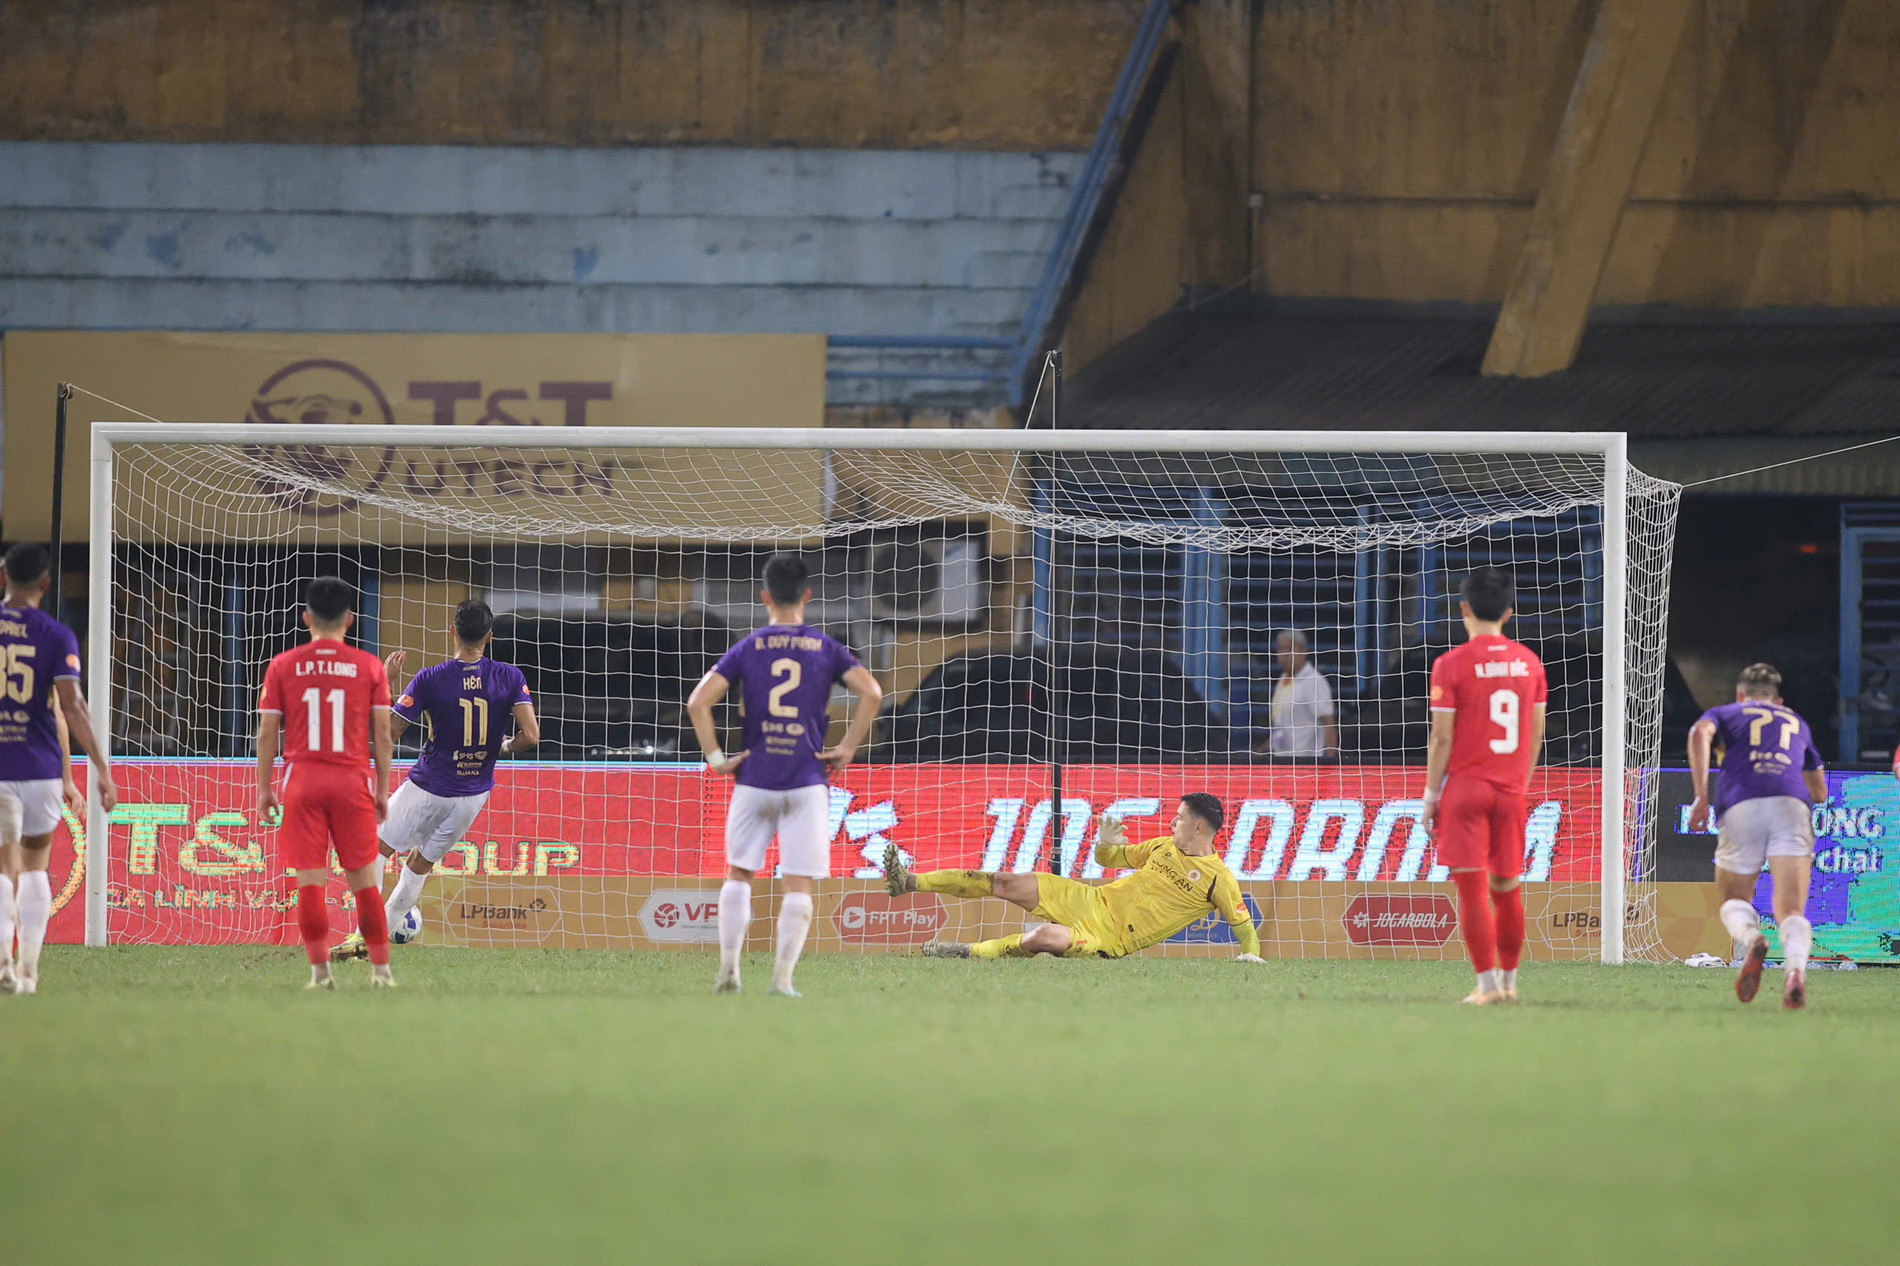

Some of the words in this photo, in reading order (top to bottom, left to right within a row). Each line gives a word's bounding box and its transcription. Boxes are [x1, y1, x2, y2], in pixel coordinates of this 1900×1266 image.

[408, 381, 614, 427] T&T
[0, 643, 36, 704] 5
[768, 657, 801, 718] 2
[302, 687, 345, 752] 11
[459, 697, 488, 747] 11
[1489, 689, 1519, 754] 9
[1742, 707, 1800, 751] 77
[460, 902, 527, 920] LPBank
[869, 911, 899, 925] FPT
[903, 910, 937, 928] Play
[1373, 912, 1448, 928] JOGARBOLA
[1553, 912, 1601, 928] LPBa
